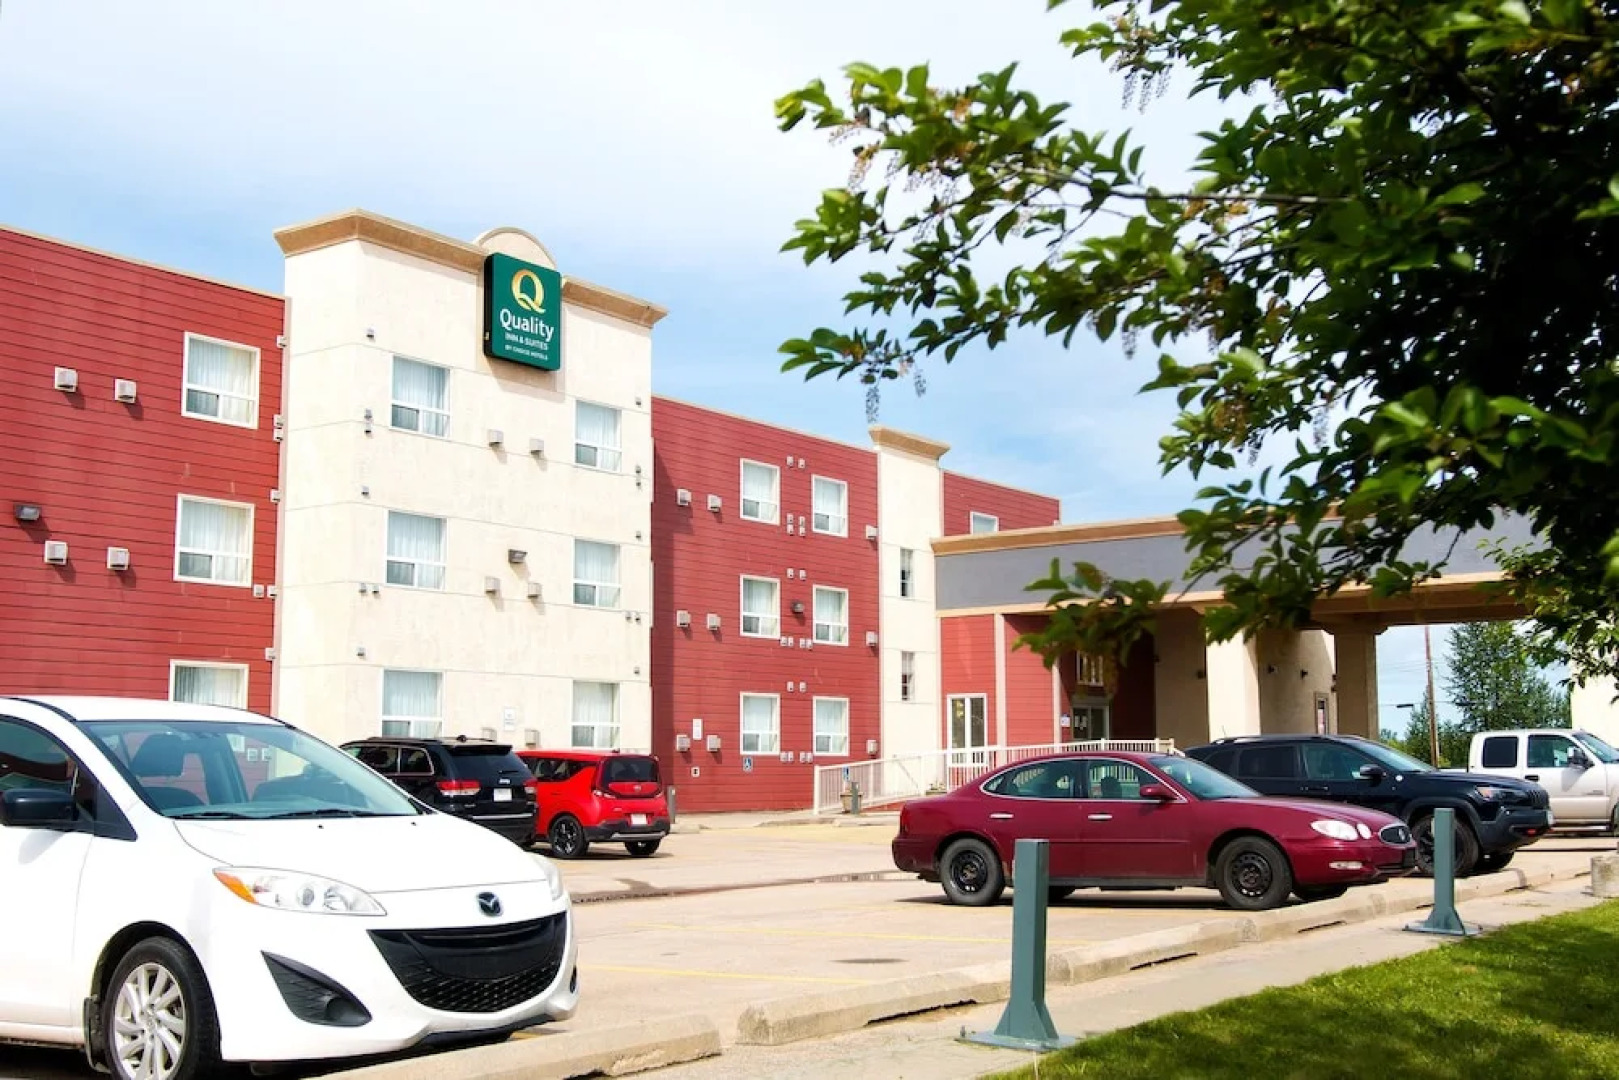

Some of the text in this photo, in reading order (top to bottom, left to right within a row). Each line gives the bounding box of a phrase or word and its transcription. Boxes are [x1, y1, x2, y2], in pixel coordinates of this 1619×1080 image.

[511, 269, 546, 313] Q
[500, 308, 554, 342] Quality
[505, 332, 518, 343] INN
[524, 337, 548, 351] SUITES
